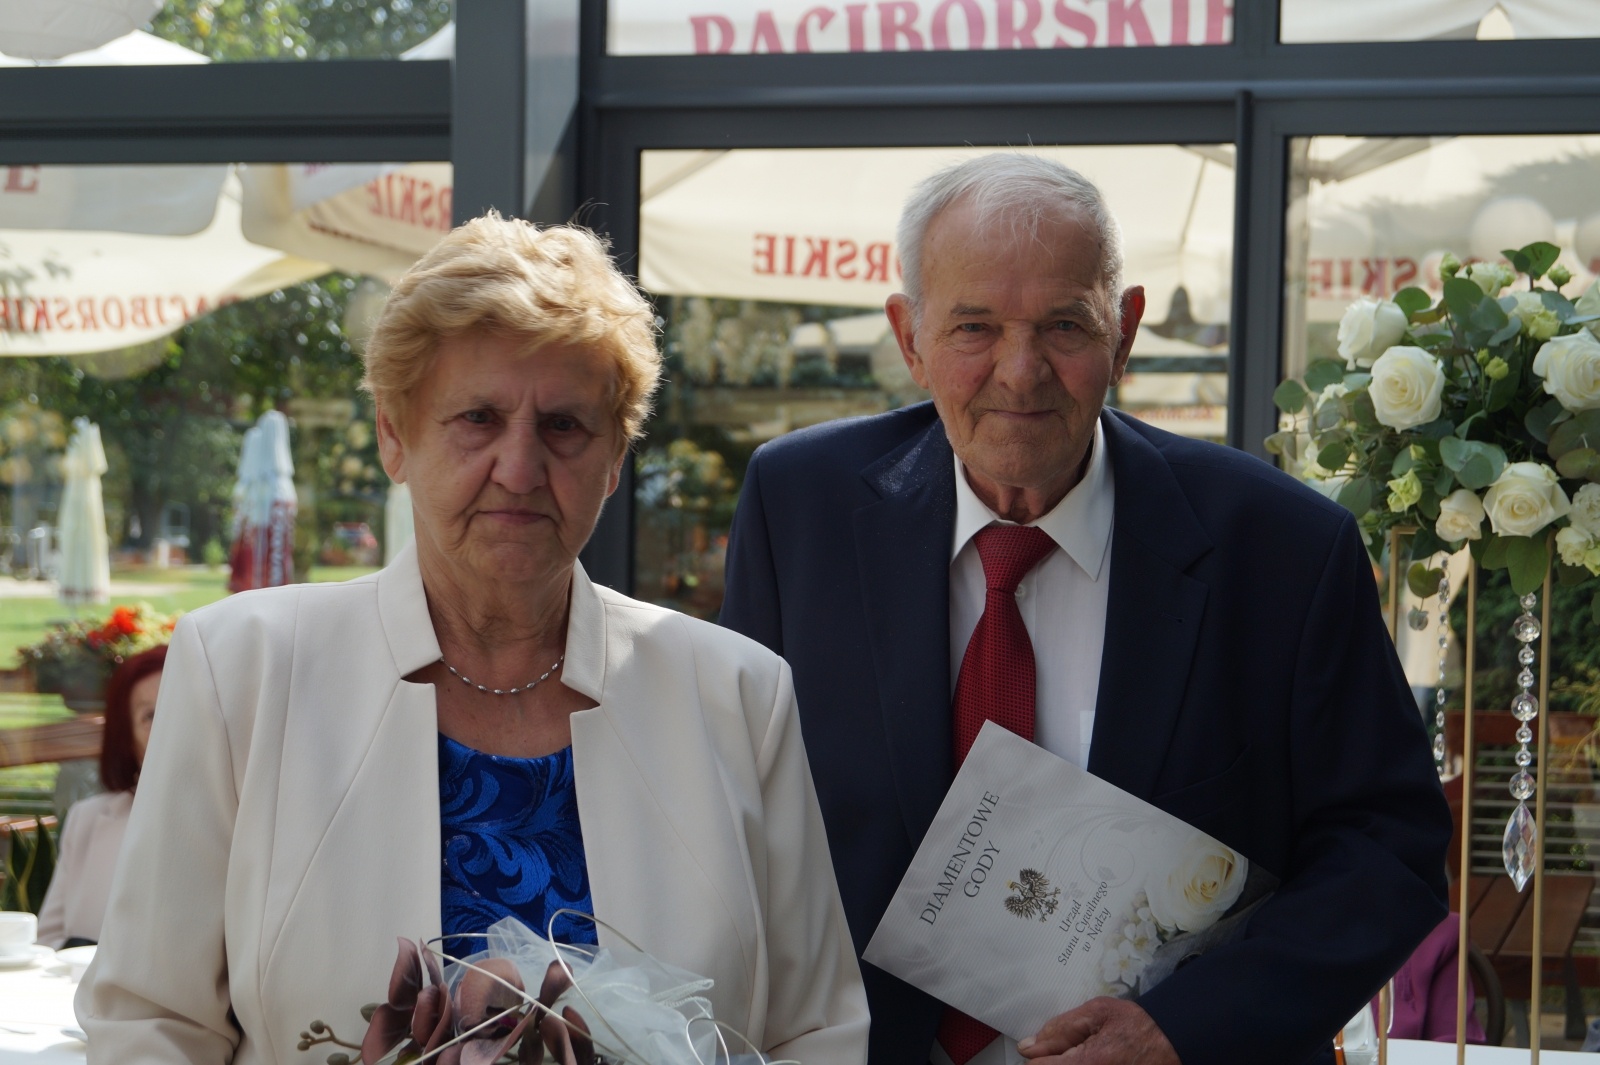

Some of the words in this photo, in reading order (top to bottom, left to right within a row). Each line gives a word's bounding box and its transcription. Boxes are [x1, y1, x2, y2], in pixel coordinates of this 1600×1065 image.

[919, 790, 1000, 926] DIAMENTOWE
[963, 840, 1001, 898] GODY
[1057, 935, 1080, 966] Stanu
[1074, 881, 1108, 933] Cywilnego
[1058, 899, 1082, 933] Urząd
[1082, 941, 1092, 953] w
